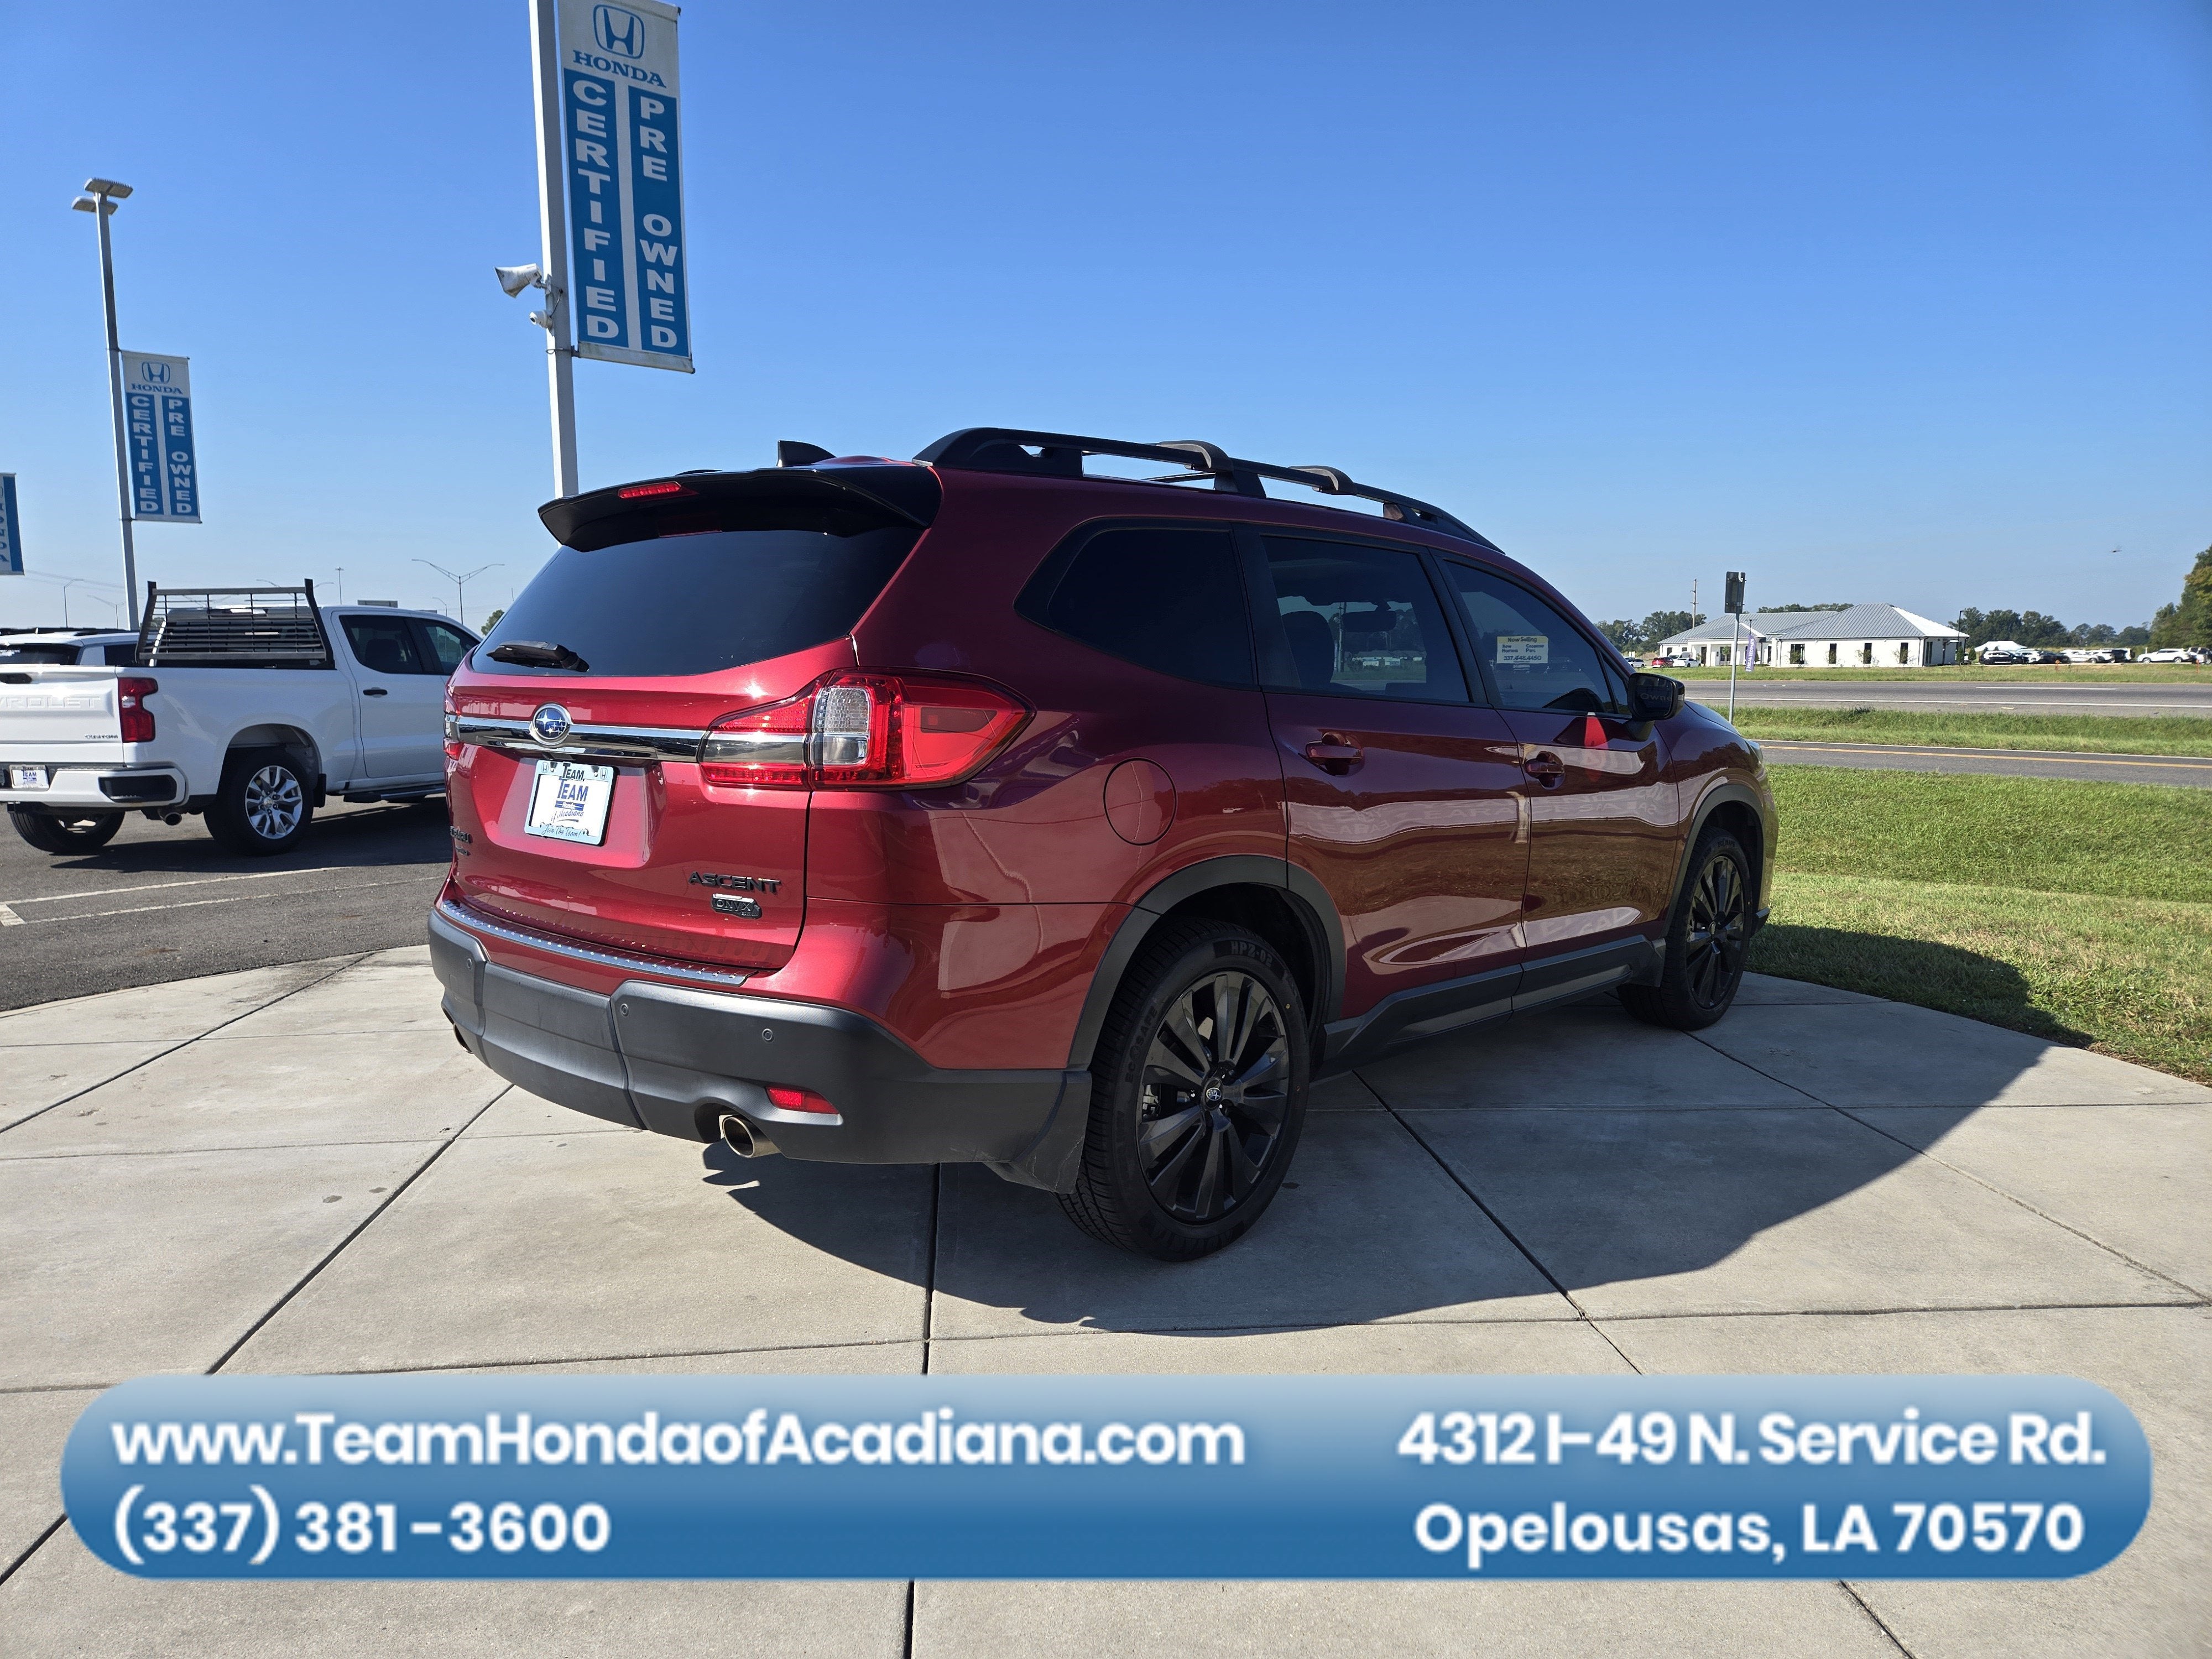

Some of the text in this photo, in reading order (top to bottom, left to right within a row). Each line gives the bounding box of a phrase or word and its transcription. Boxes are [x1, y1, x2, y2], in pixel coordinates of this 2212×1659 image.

[572, 50, 666, 88] HONDA
[573, 80, 619, 339] CERTIFIED
[639, 95, 678, 349] PRE OWNED
[131, 383, 184, 394] HONDA
[131, 396, 159, 513] CERTIFIED
[168, 398, 192, 514] PRE OWNED
[562, 762, 585, 780] TEAM
[557, 776, 589, 802] TEAM
[688, 871, 782, 893] ASCENT
[717, 899, 751, 912] ONYX
